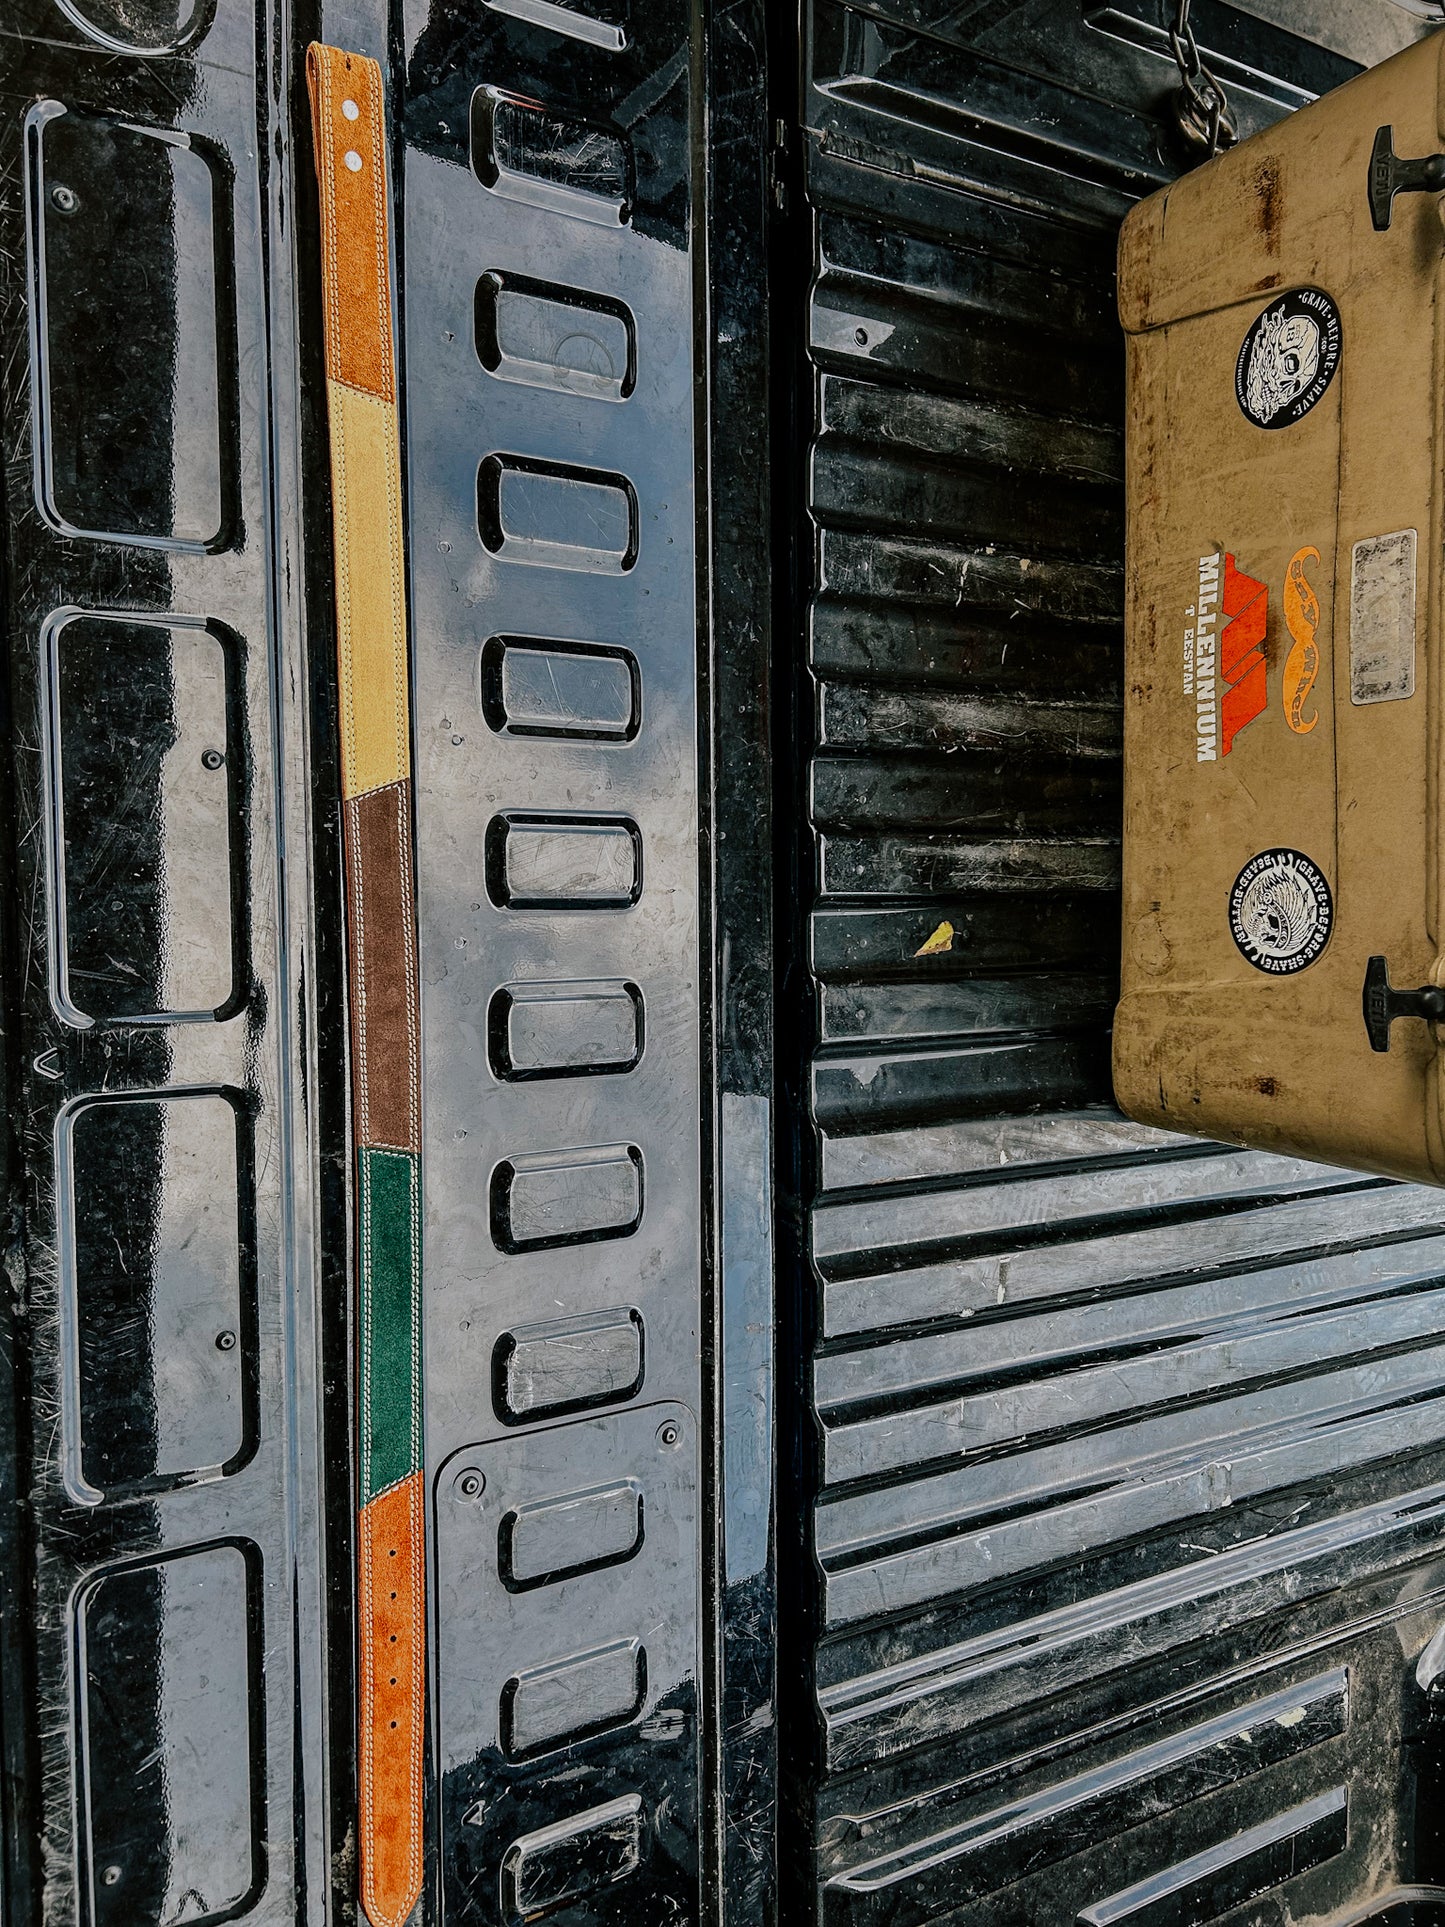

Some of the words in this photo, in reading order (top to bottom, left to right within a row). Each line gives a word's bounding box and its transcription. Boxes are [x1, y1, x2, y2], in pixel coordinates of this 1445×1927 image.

[1375, 153, 1392, 197] YETI
[1301, 291, 1332, 317] GRAVE
[1324, 318, 1339, 369] BEFORE
[1297, 376, 1327, 416] SHAVE
[1196, 552, 1220, 763] MILLENNIUM
[1290, 645, 1316, 728] When
[1239, 854, 1271, 887] BEARD
[1299, 860, 1328, 902] GRAVE
[1231, 888, 1249, 943] BUTTER
[1308, 906, 1329, 958] BEFORE
[1263, 954, 1305, 971] SHAVE
